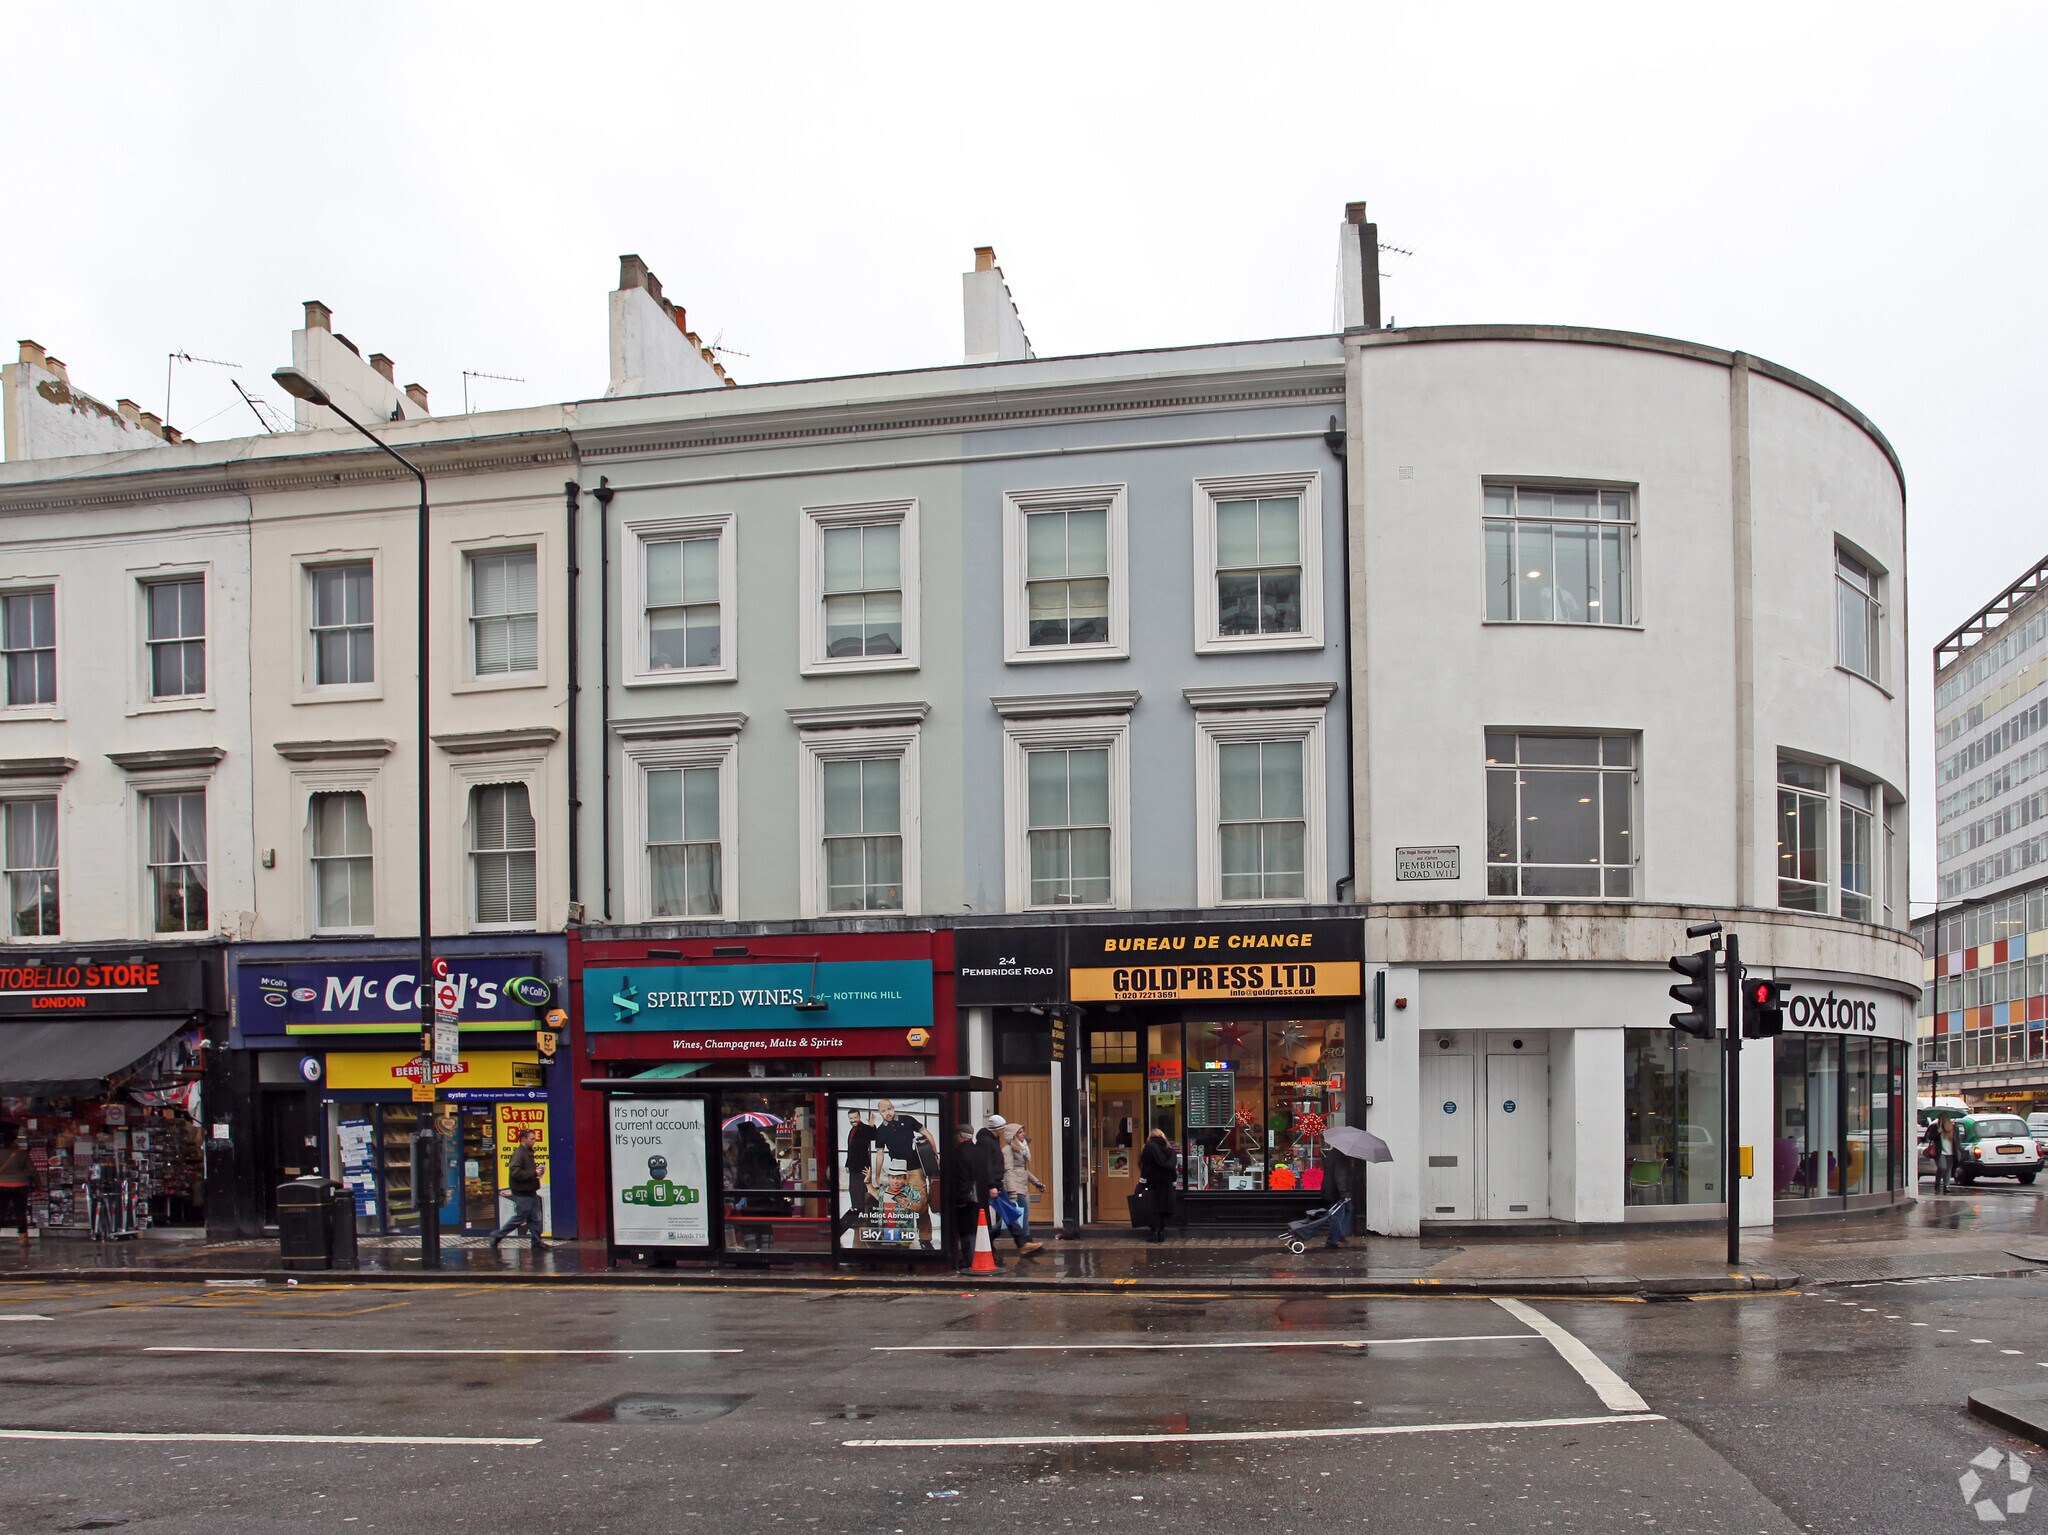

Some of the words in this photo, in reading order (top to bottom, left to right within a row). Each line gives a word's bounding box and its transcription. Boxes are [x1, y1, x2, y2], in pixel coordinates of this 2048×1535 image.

[1400, 861, 1456, 869] PEMBRIDGE
[1104, 936, 1186, 952] BUREAU
[1194, 936, 1220, 950] DE
[1228, 933, 1312, 949] CHANGE
[998, 957, 1016, 965] 2-4
[85, 964, 160, 987] STORE
[1112, 965, 1264, 992] GOLDPRESS
[1271, 964, 1316, 988] LTD
[260, 977, 288, 988] McColl's
[520, 984, 548, 998] McColl's
[834, 992, 878, 1000] NOTTING
[880, 990, 902, 999] HILL
[1230, 988, 1316, 997] info@goldpress.co.uk
[32, 997, 86, 1008] LONDON
[647, 991, 734, 1008] SPIRITED
[738, 989, 804, 1006] WINES
[1775, 983, 1876, 1032] Foxtons
[672, 1040, 702, 1050] Wines,
[704, 1040, 767, 1050] Champagnes,
[770, 1038, 797, 1047] Malts
[799, 1038, 808, 1047] &
[810, 1037, 843, 1049] Spirits
[1150, 1064, 1165, 1076] Ria
[502, 1106, 543, 1121] SPEND
[614, 1106, 628, 1118] It's
[630, 1106, 648, 1118] not
[650, 1108, 669, 1117] our
[615, 1120, 652, 1130] current
[656, 1120, 700, 1130] account.
[508, 1128, 541, 1140] SE
[615, 1134, 628, 1145] It's
[631, 1136, 663, 1147] yours.
[862, 1228, 882, 1241] sky
[888, 1229, 894, 1240] 1
[901, 1231, 916, 1240] HD
